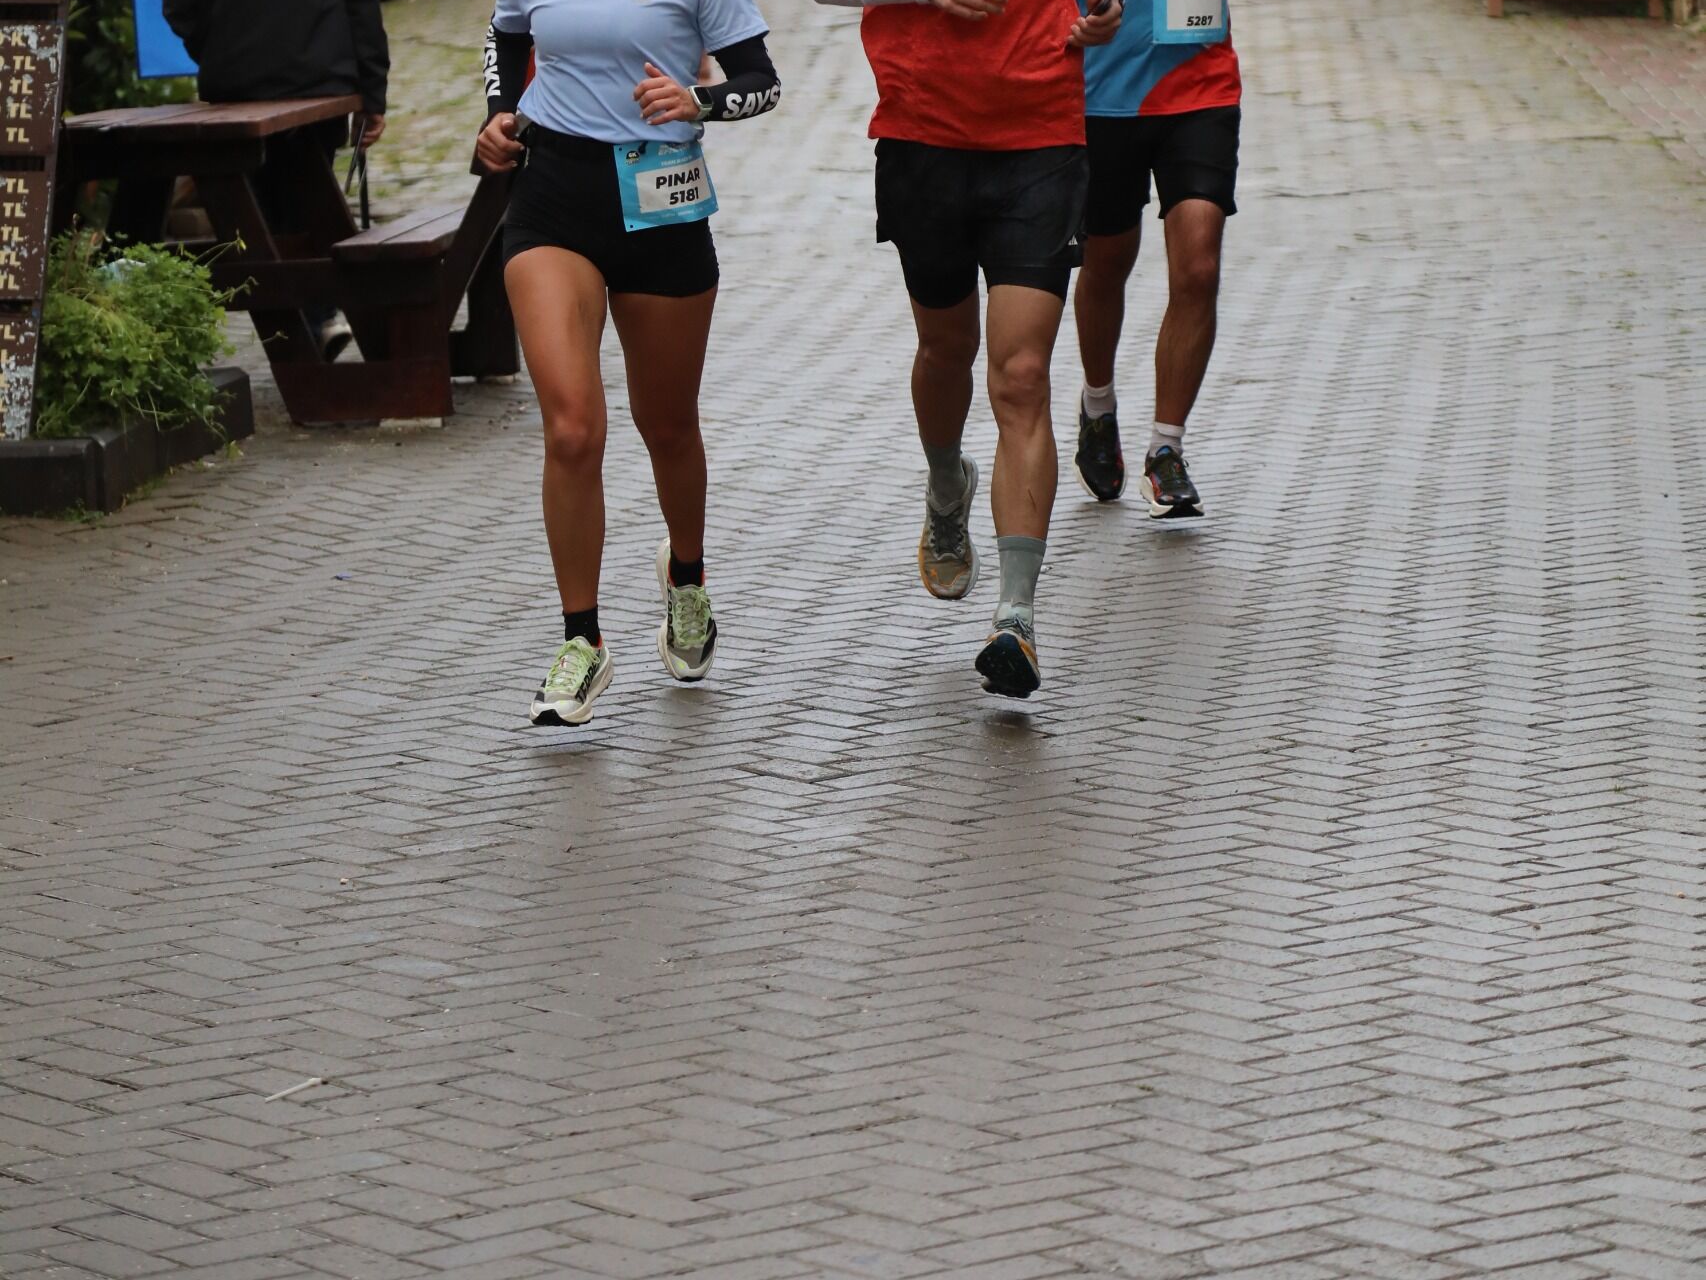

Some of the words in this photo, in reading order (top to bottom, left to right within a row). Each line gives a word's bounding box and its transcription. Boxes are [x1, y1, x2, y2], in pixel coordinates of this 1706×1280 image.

[1186, 15, 1213, 26] 5287
[13, 56, 36, 70] TL
[10, 79, 33, 94] TL
[722, 81, 780, 119] SAYS
[10, 103, 32, 118] TL
[6, 127, 29, 142] TL
[6, 178, 29, 194] TL
[656, 168, 700, 189] PINAR
[669, 187, 699, 205] 5181
[3, 202, 26, 217] TL
[1, 226, 23, 241] TL
[0, 325, 15, 339] L
